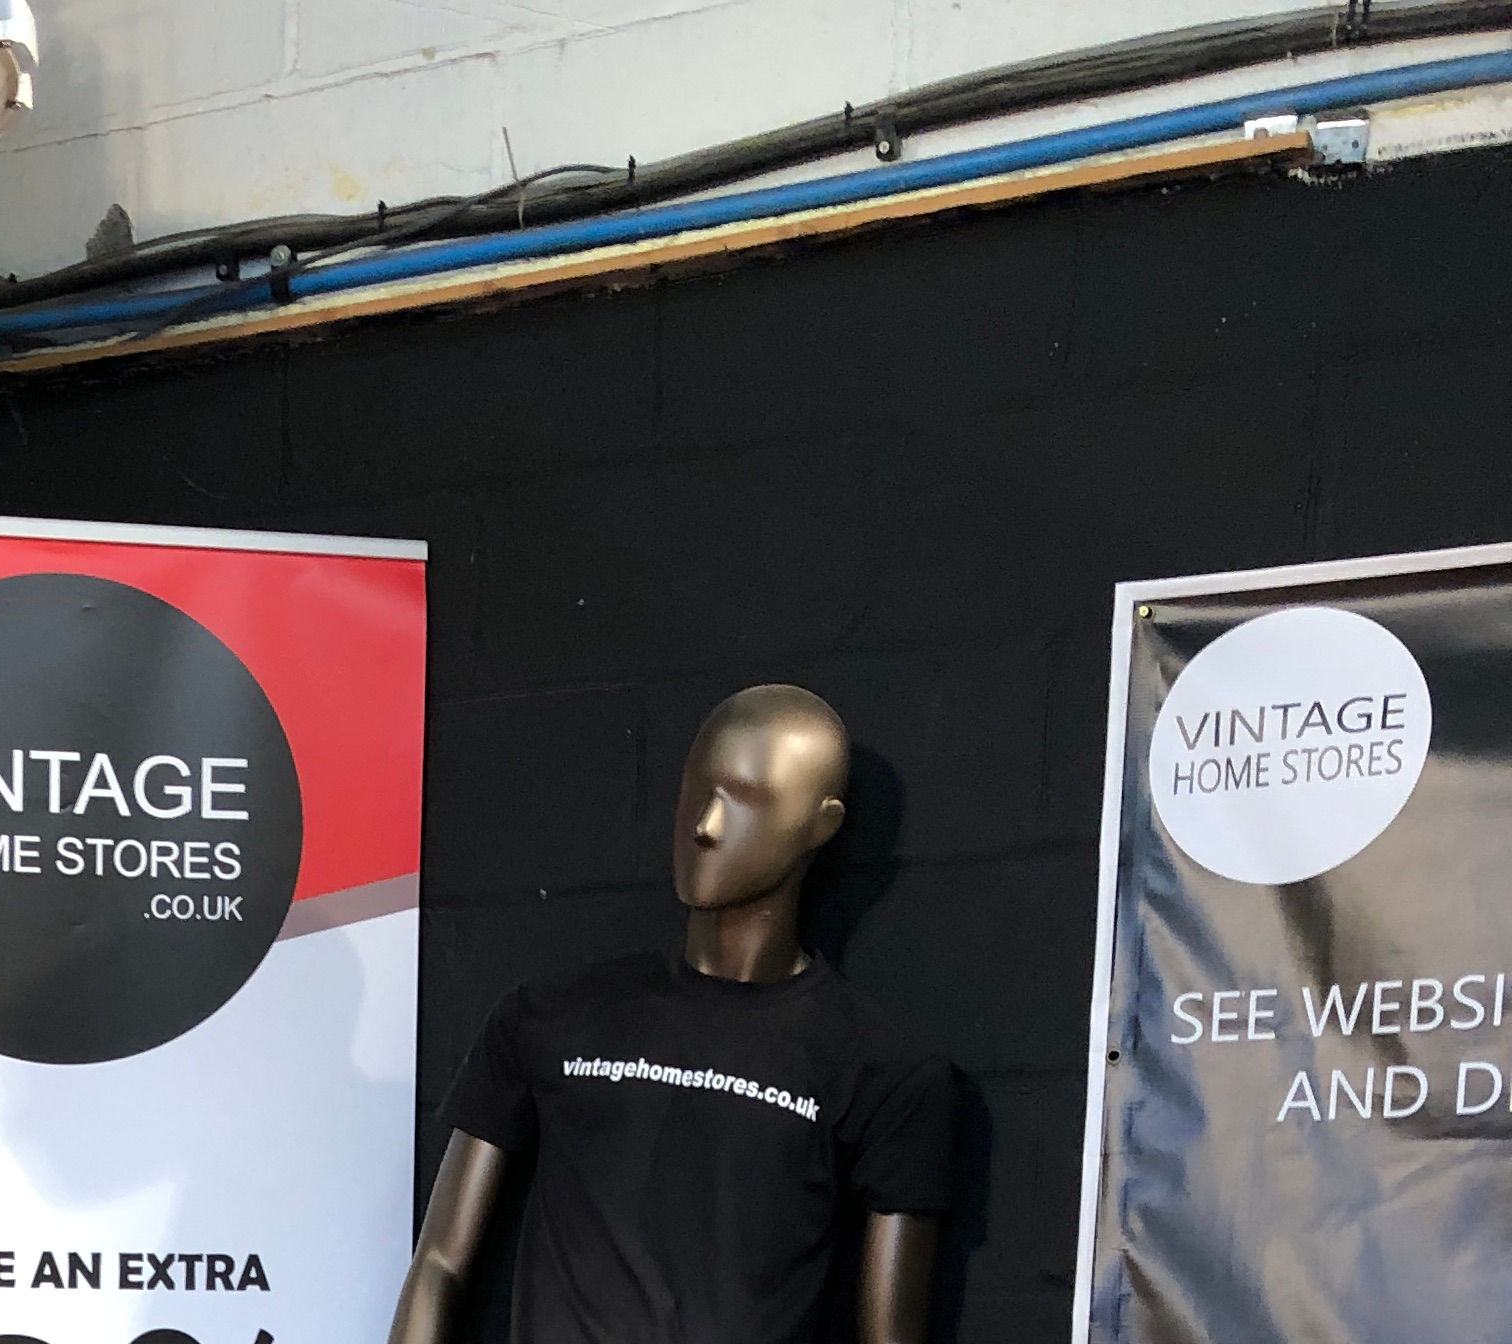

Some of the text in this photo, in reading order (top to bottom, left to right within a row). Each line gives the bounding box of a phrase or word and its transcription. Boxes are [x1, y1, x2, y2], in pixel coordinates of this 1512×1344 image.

[1175, 693, 1408, 750] VINTAGE
[1173, 739, 1404, 796] HOME STORES
[55, 837, 242, 881] STORES
[143, 894, 243, 922] .CO.UK
[1170, 988, 1277, 1044] SEE
[562, 1057, 820, 1122] vintagehomestores.co.uk
[1276, 1065, 1429, 1122] AND
[31, 1252, 102, 1290] AN
[118, 1253, 271, 1292] EXTRA
